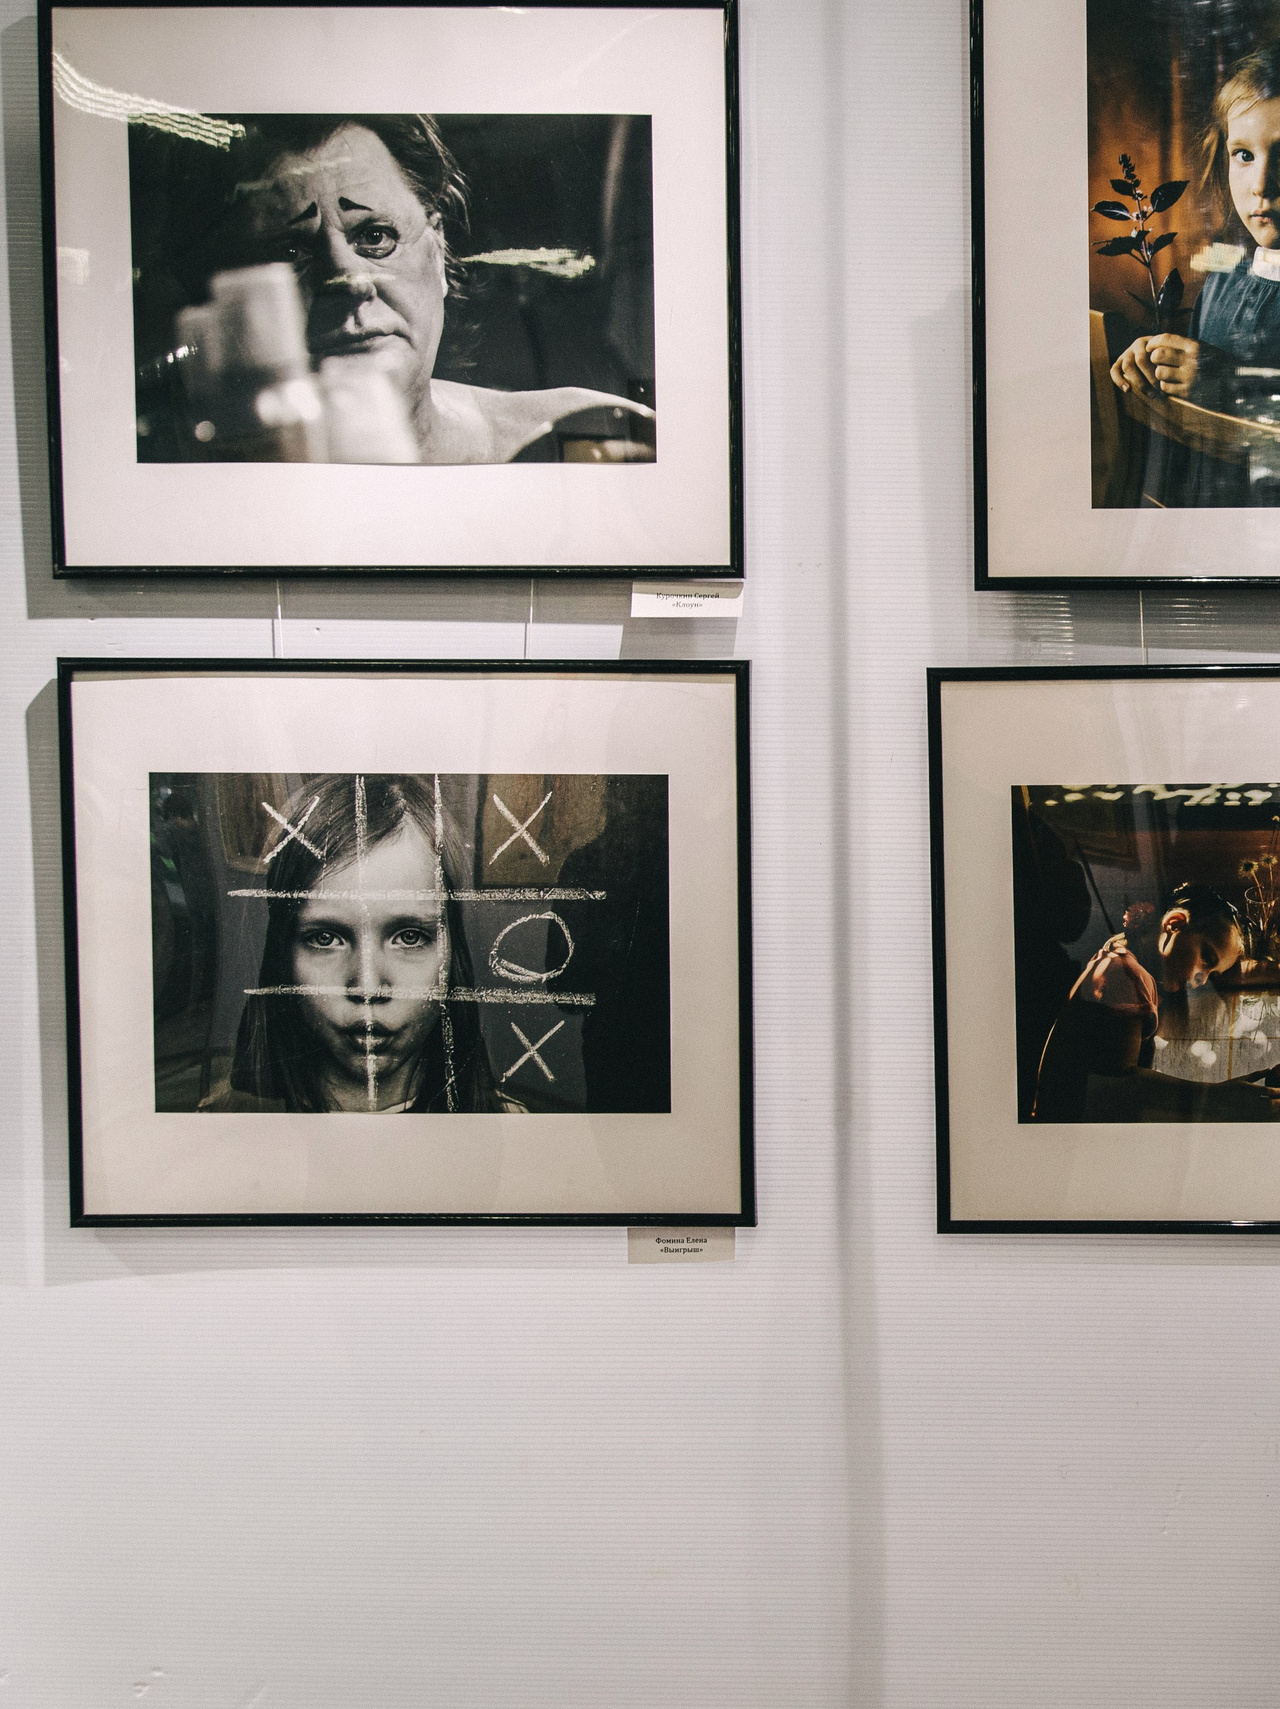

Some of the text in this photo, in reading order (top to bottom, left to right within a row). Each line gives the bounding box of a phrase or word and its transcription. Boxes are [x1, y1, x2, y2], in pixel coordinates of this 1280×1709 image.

[656, 592, 720, 600] Курочкин Сергей
[671, 601, 703, 609] «Клоун»
[655, 1236, 708, 1245] Фомина Елена
[660, 1246, 704, 1255] «Выигрыш»
